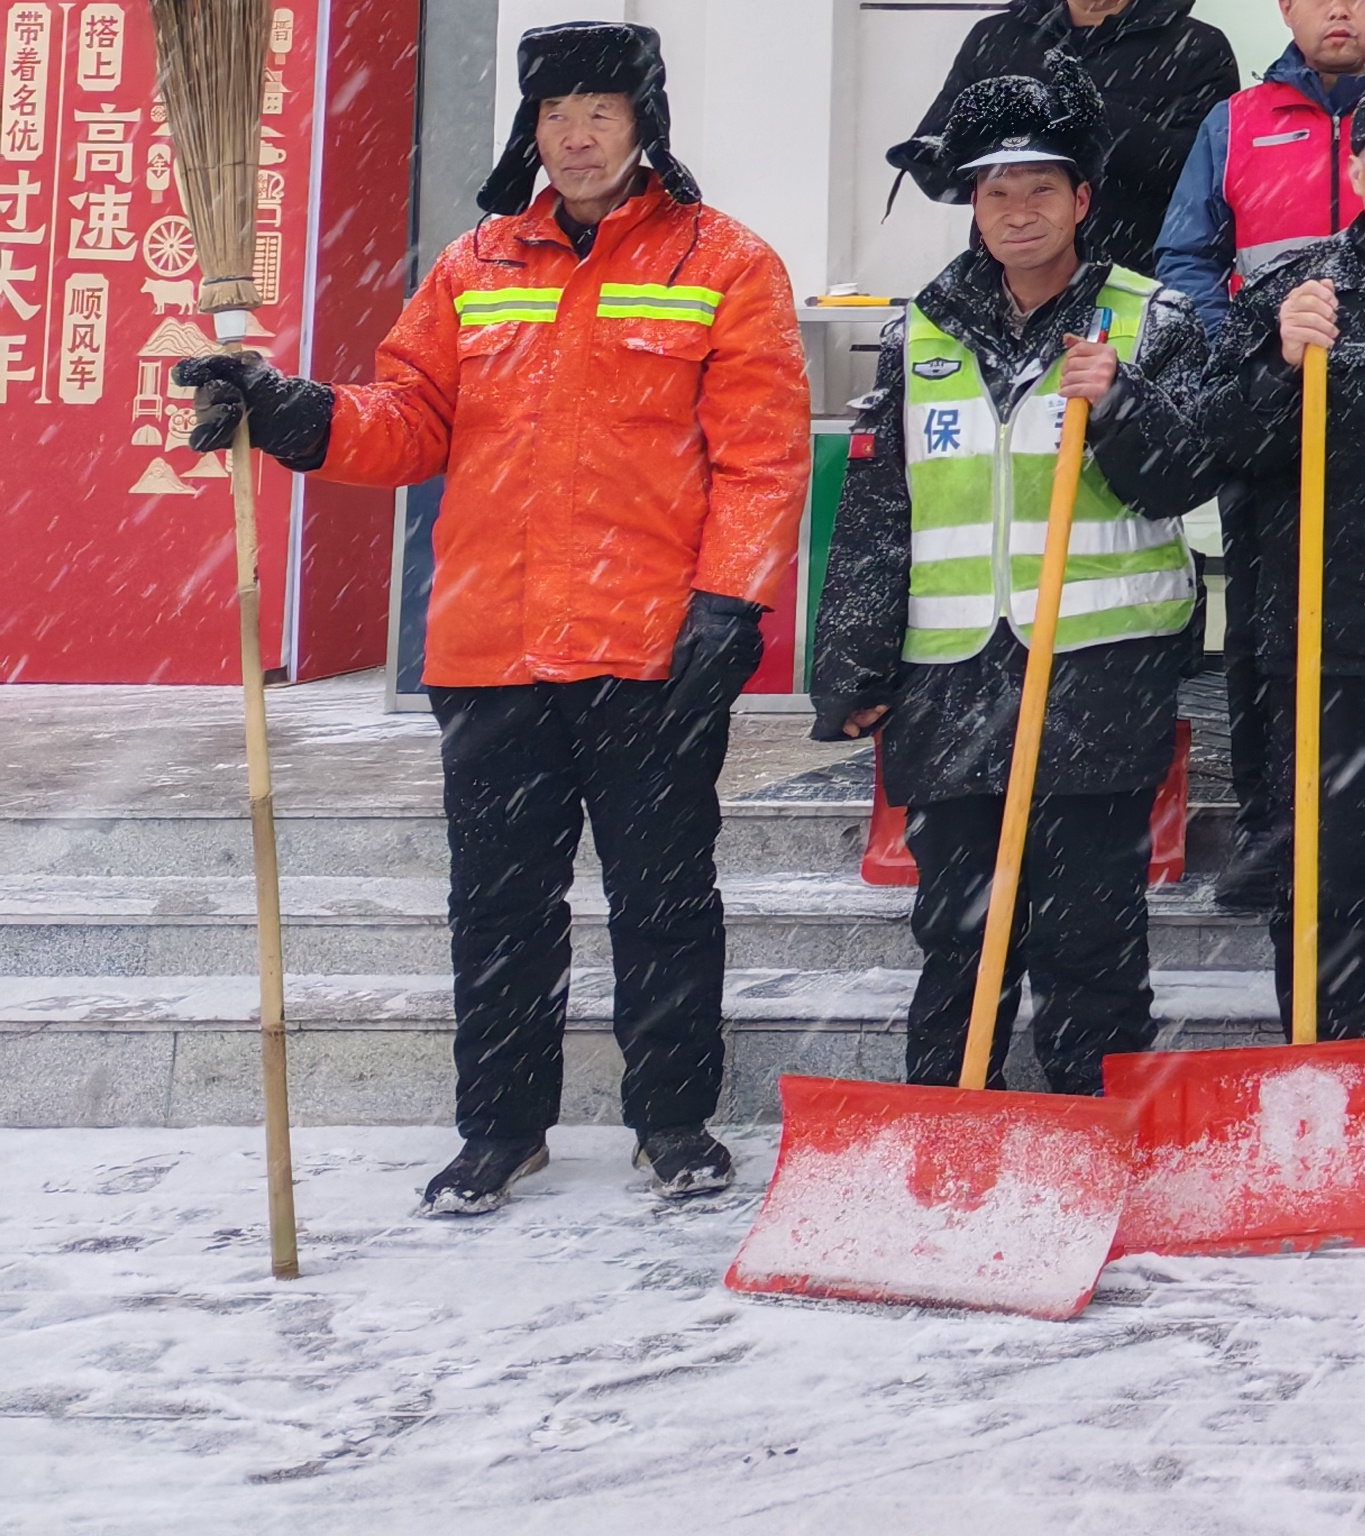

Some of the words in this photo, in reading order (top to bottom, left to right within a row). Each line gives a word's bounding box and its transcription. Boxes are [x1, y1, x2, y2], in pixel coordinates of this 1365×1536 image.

[5, 11, 45, 154] 带着名优
[82, 14, 120, 81] 搭上
[67, 103, 142, 263] 高速
[65, 287, 104, 392] 顺风车
[923, 408, 961, 454] 保
